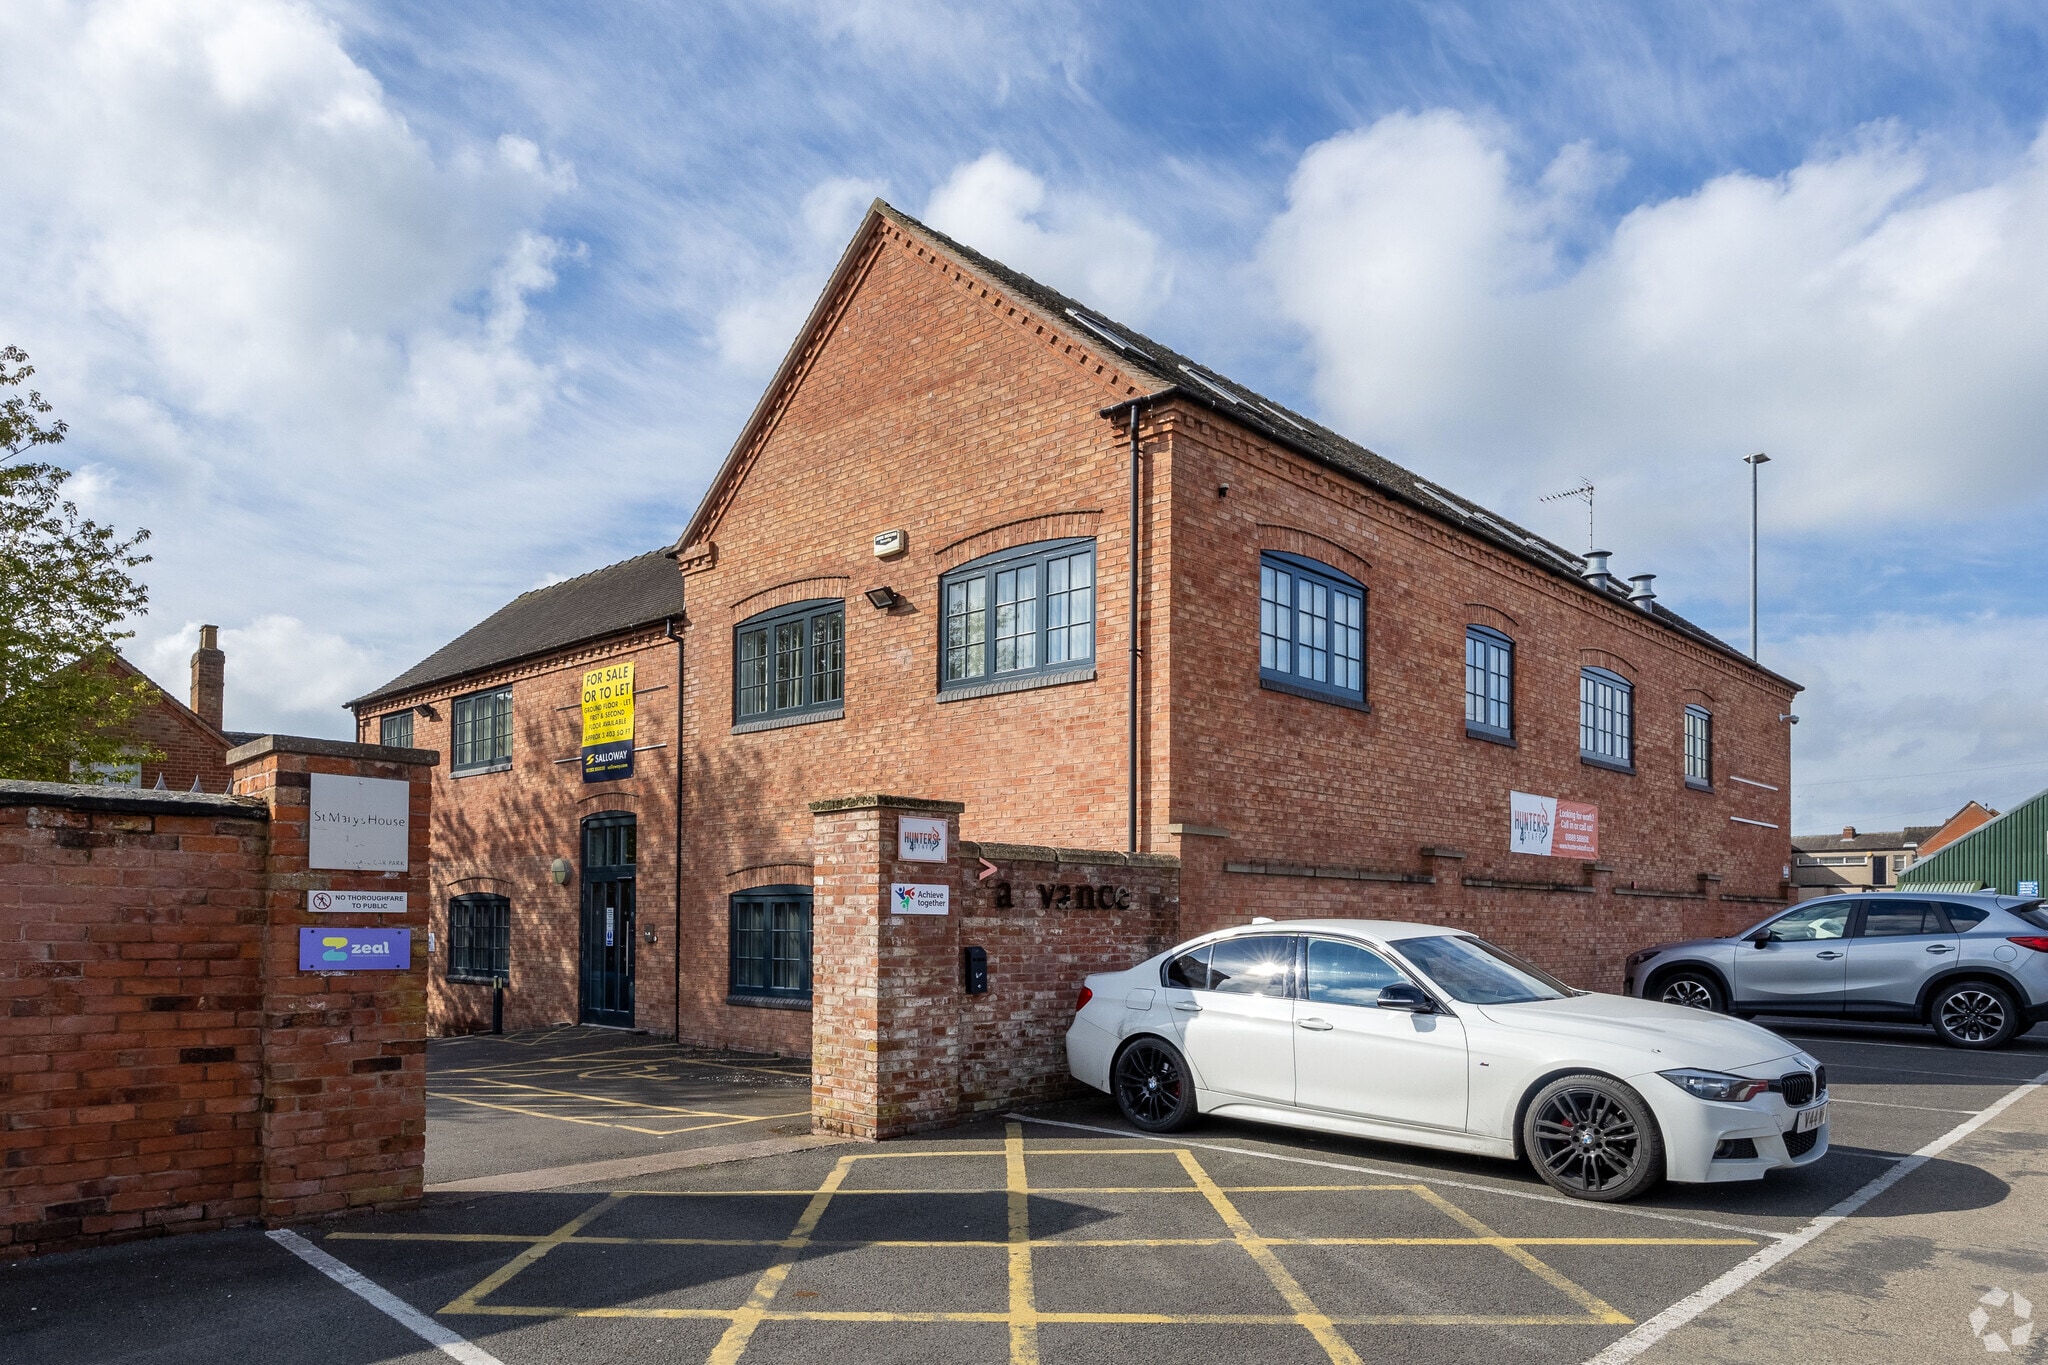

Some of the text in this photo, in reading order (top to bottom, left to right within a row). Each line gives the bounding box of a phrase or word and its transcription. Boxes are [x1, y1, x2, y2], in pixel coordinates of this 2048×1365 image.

[586, 665, 629, 687] FOR SALE
[584, 682, 630, 703] OR TO LET
[584, 704, 602, 714] GROUND
[603, 700, 618, 710] FLOOR
[623, 698, 631, 706] LET
[590, 713, 600, 721] FIRST
[605, 709, 625, 719] SECOND
[589, 717, 627, 730] FLOOR AVAILABLE
[585, 732, 601, 742] APPROX
[616, 729, 624, 737] SQ
[595, 749, 628, 764] SALLOWAY
[314, 810, 326, 822] St
[368, 814, 405, 827] House
[1514, 810, 1547, 833] HUNTERS
[904, 831, 939, 846] HUNTERS
[347, 894, 404, 902] THOROUGHFARE
[917, 890, 944, 899] Achieve
[917, 899, 946, 909] together
[351, 941, 390, 954] zeal
